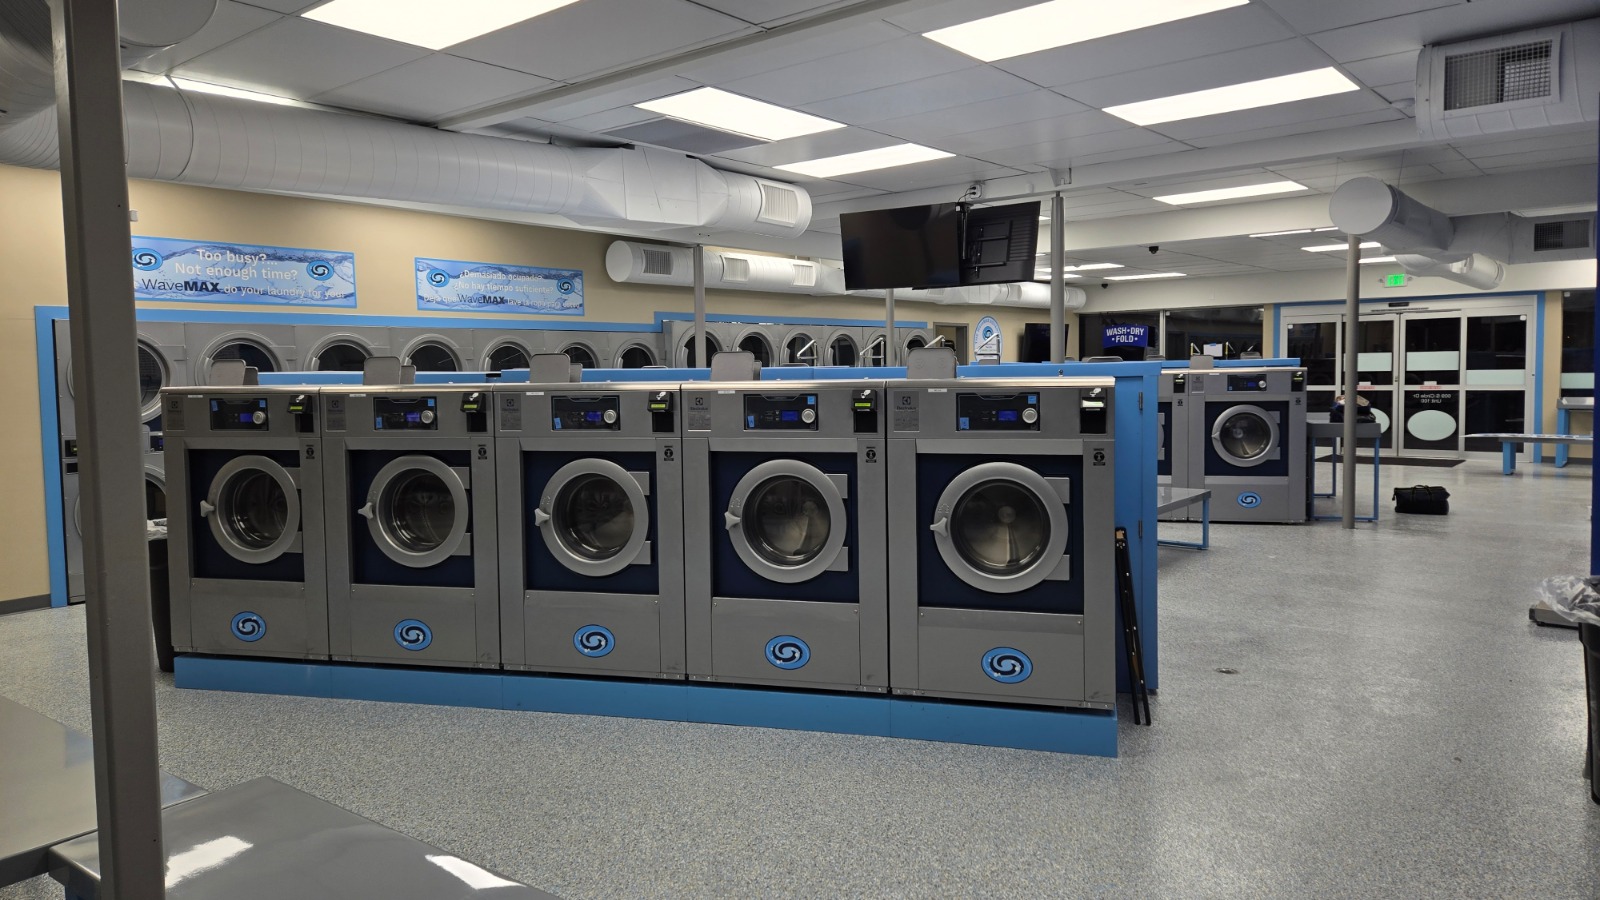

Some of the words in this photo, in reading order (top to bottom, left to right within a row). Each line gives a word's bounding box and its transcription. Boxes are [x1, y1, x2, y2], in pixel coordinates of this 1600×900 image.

[196, 249, 222, 261] Too
[175, 262, 202, 275] Not
[206, 266, 257, 280] enough
[261, 268, 298, 280] time?
[141, 278, 220, 292] WaveMAX
[224, 284, 238, 294] do
[241, 287, 263, 297] your
[267, 286, 305, 298] laundry
[308, 288, 321, 298] for
[471, 281, 484, 291] hay
[487, 283, 514, 293] tiempo
[515, 284, 554, 294] suficiente?
[457, 293, 505, 304] WaveMAX
[1115, 335, 1134, 343] FOLD
